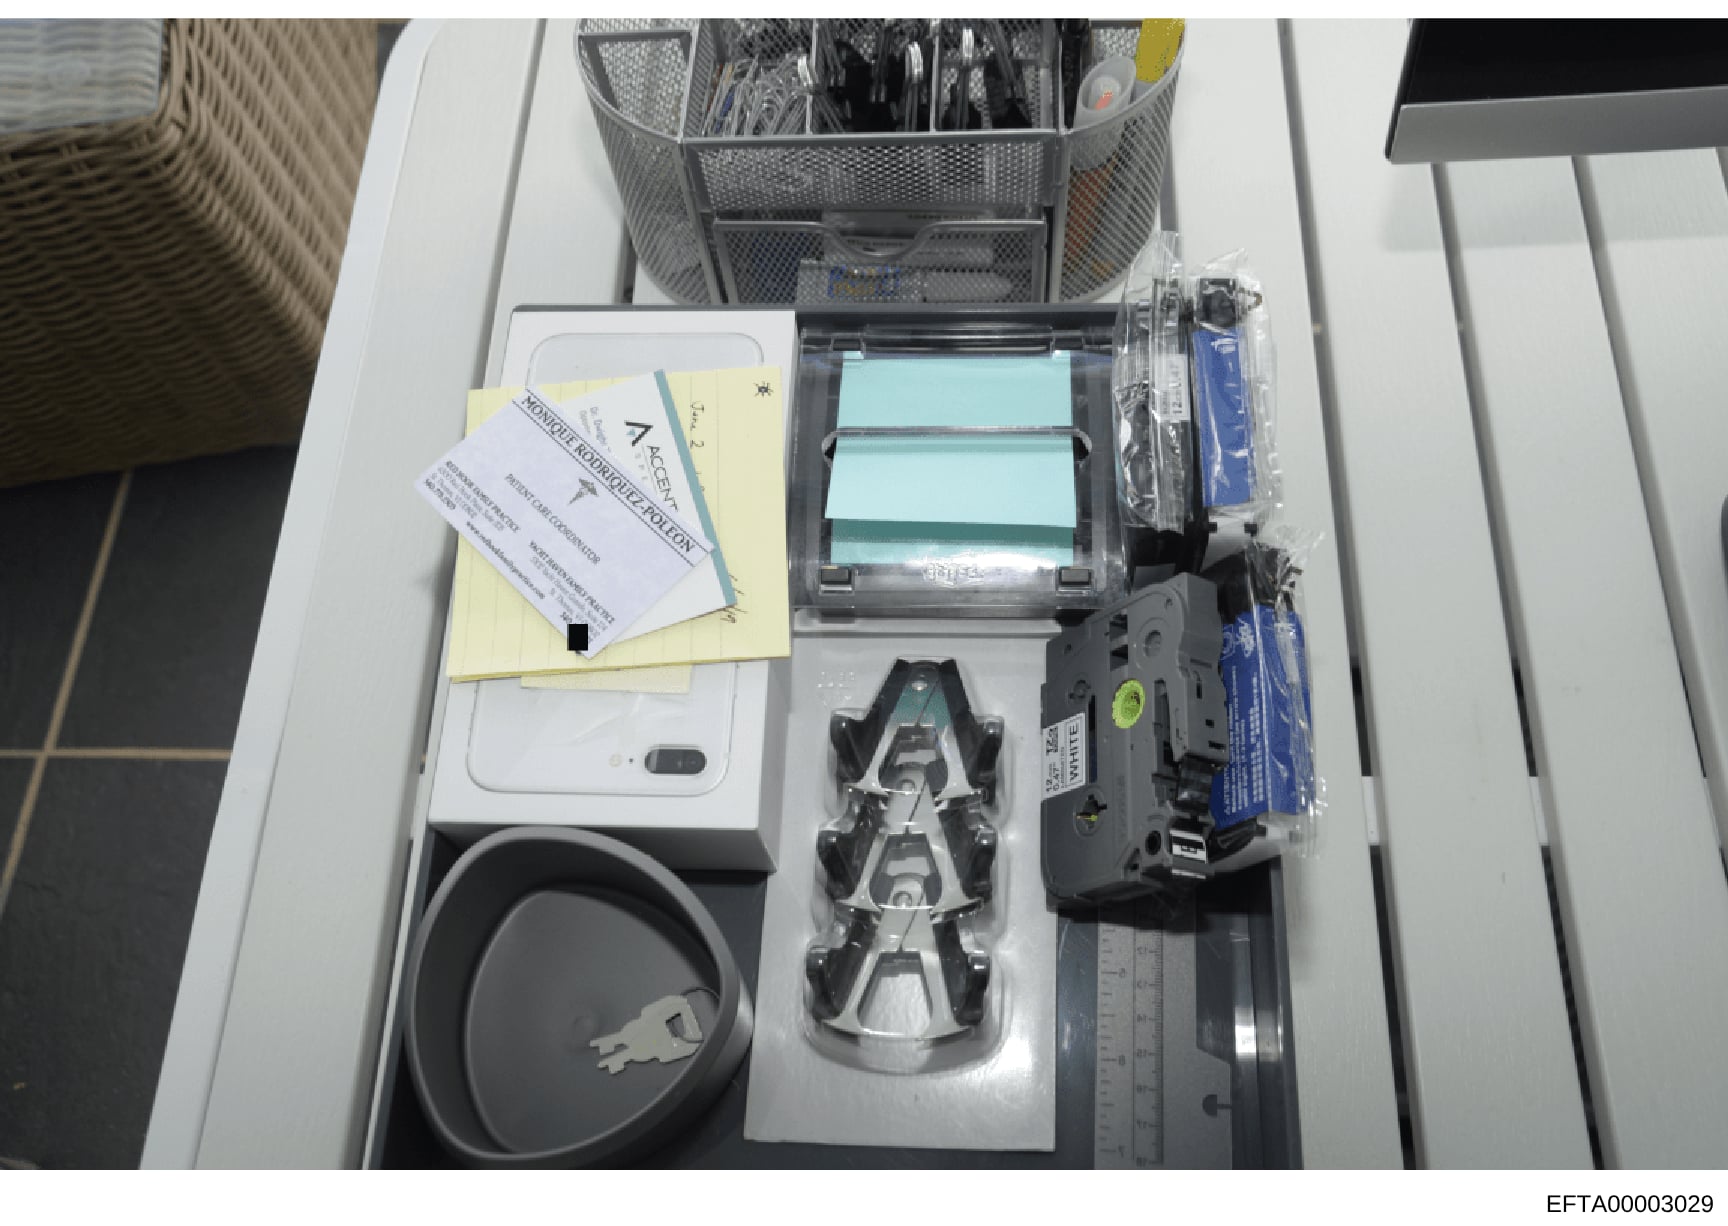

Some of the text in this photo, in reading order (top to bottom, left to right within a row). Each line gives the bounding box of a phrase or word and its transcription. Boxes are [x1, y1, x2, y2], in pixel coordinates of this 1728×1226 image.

[521, 396, 697, 553] MONIQUE RODRIQUEZ-POLEON
[647, 445, 678, 510] ACCENT
[472, 486, 494, 506] FAMILY
[491, 504, 521, 533] PRACTICE
[505, 474, 600, 565] PATIENT CARE COORDINATOR
[564, 575, 588, 597] FAMILY
[584, 595, 615, 624] PRACTICE
[1069, 723, 1079, 782] WHITE
